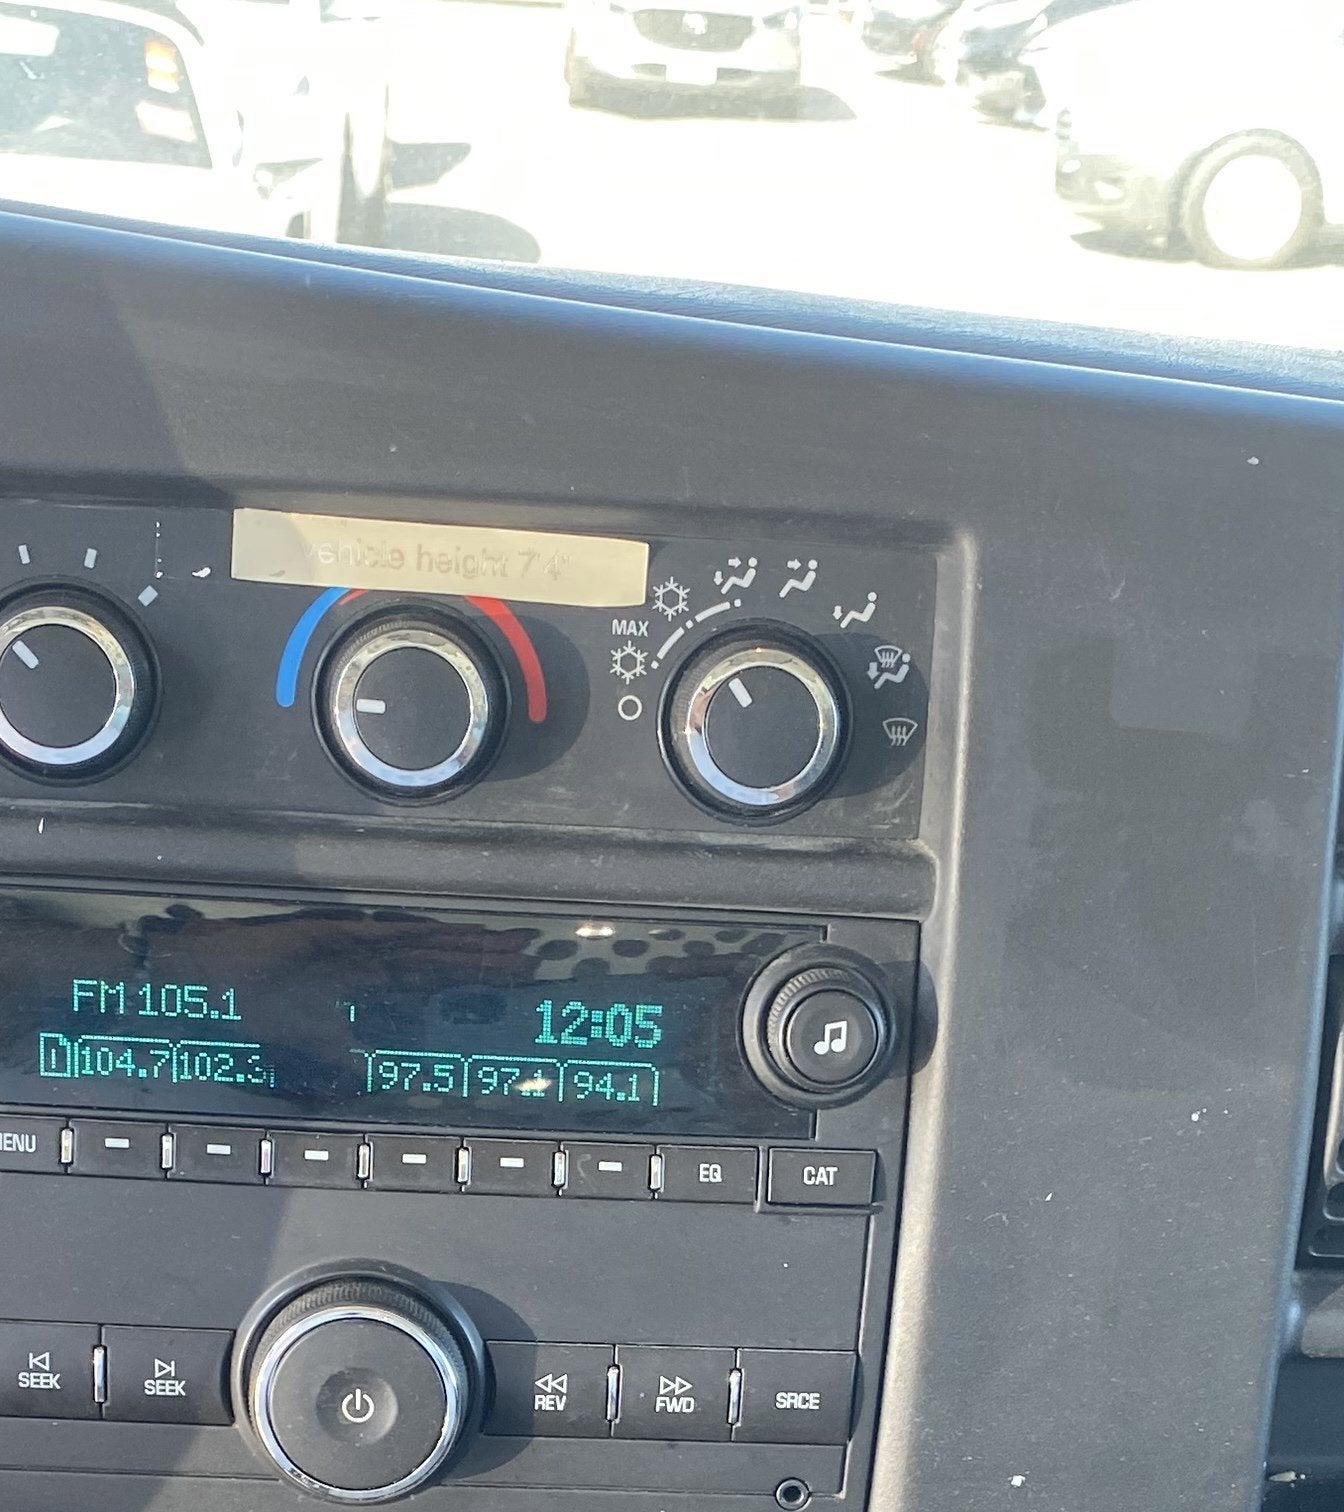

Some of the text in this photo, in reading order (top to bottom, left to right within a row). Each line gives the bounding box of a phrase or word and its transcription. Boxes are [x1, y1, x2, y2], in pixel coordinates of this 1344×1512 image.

[304, 537, 406, 571] vehicle
[416, 543, 509, 579] height
[612, 618, 649, 637] MAX
[72, 978, 242, 1021] FM 105.1
[534, 999, 664, 1049] 12:05
[81, 1046, 170, 1080] 104.7
[179, 1050, 265, 1085] 102.3
[378, 1061, 455, 1093] 97.5
[573, 1070, 641, 1102] 94.1
[698, 1163, 723, 1184] EQ
[802, 1166, 839, 1187] CAT
[17, 1371, 62, 1391] SEEK
[143, 1378, 187, 1398] SEEK
[534, 1394, 567, 1412] REV
[655, 1396, 696, 1414] FWD
[775, 1391, 821, 1411] SRCE
